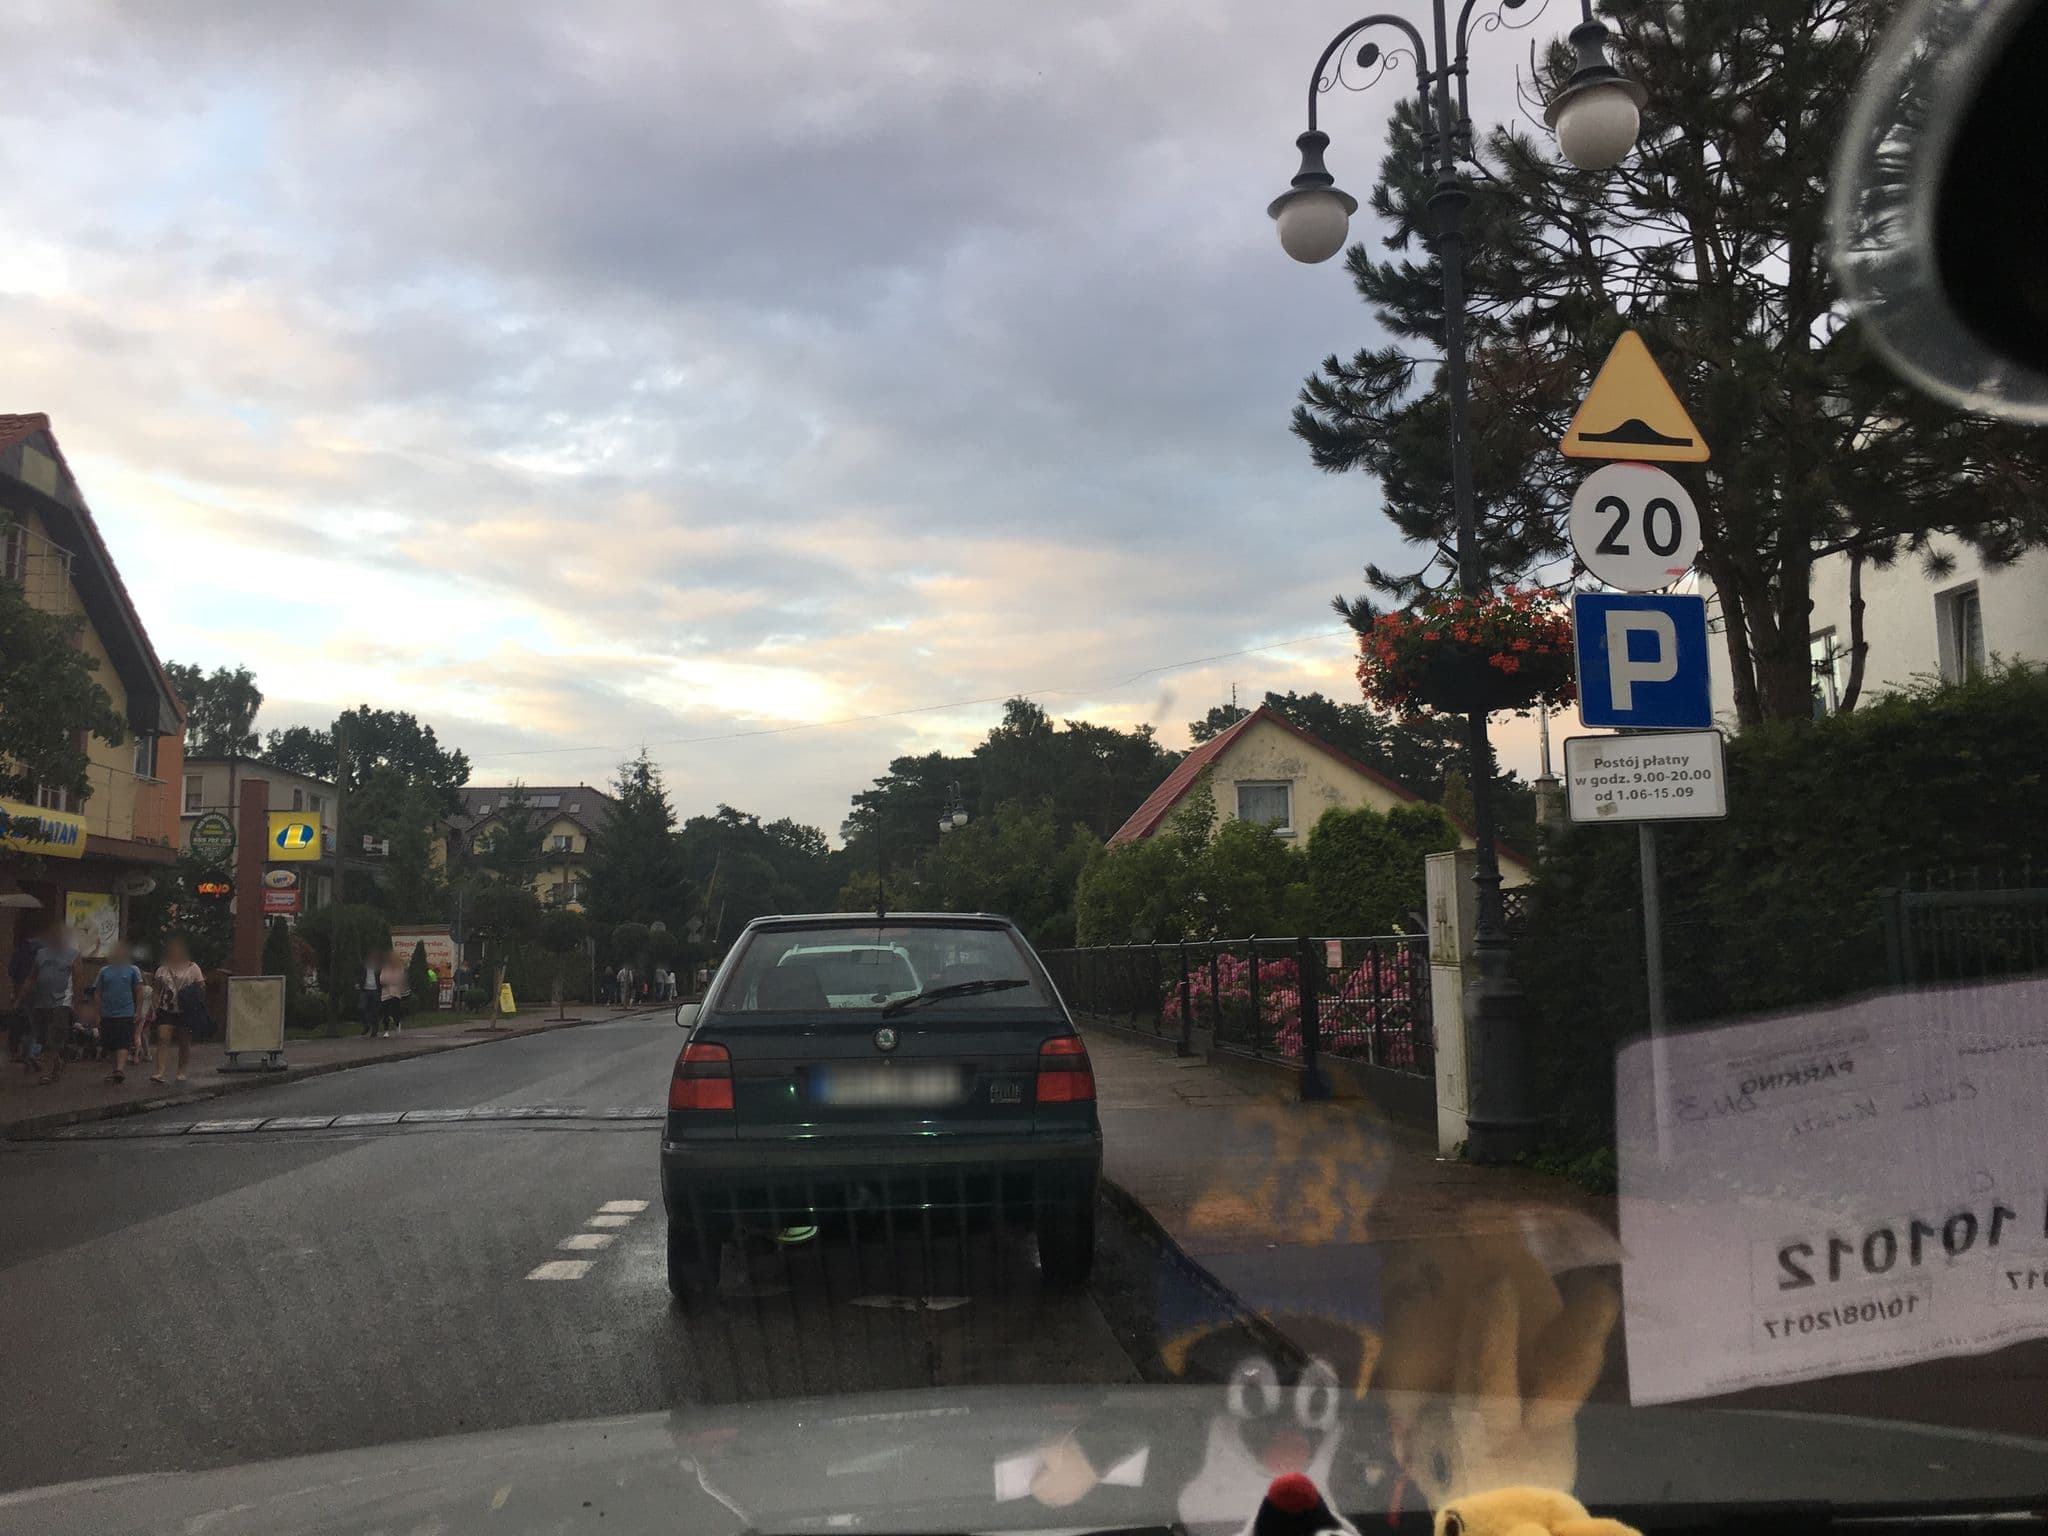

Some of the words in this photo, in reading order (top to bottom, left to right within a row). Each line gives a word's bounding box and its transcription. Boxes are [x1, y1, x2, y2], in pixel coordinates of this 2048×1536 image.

[1594, 495, 1682, 556] 20
[1605, 609, 1677, 711] P
[1594, 756, 1639, 769] Postój
[1643, 755, 1690, 768] płatny
[1575, 777, 1586, 785] w
[1590, 773, 1630, 787] godz.
[1633, 769, 1712, 782] 9.00-20.00
[1595, 790, 1612, 801] od
[1617, 787, 1694, 800] 1.06-15.09
